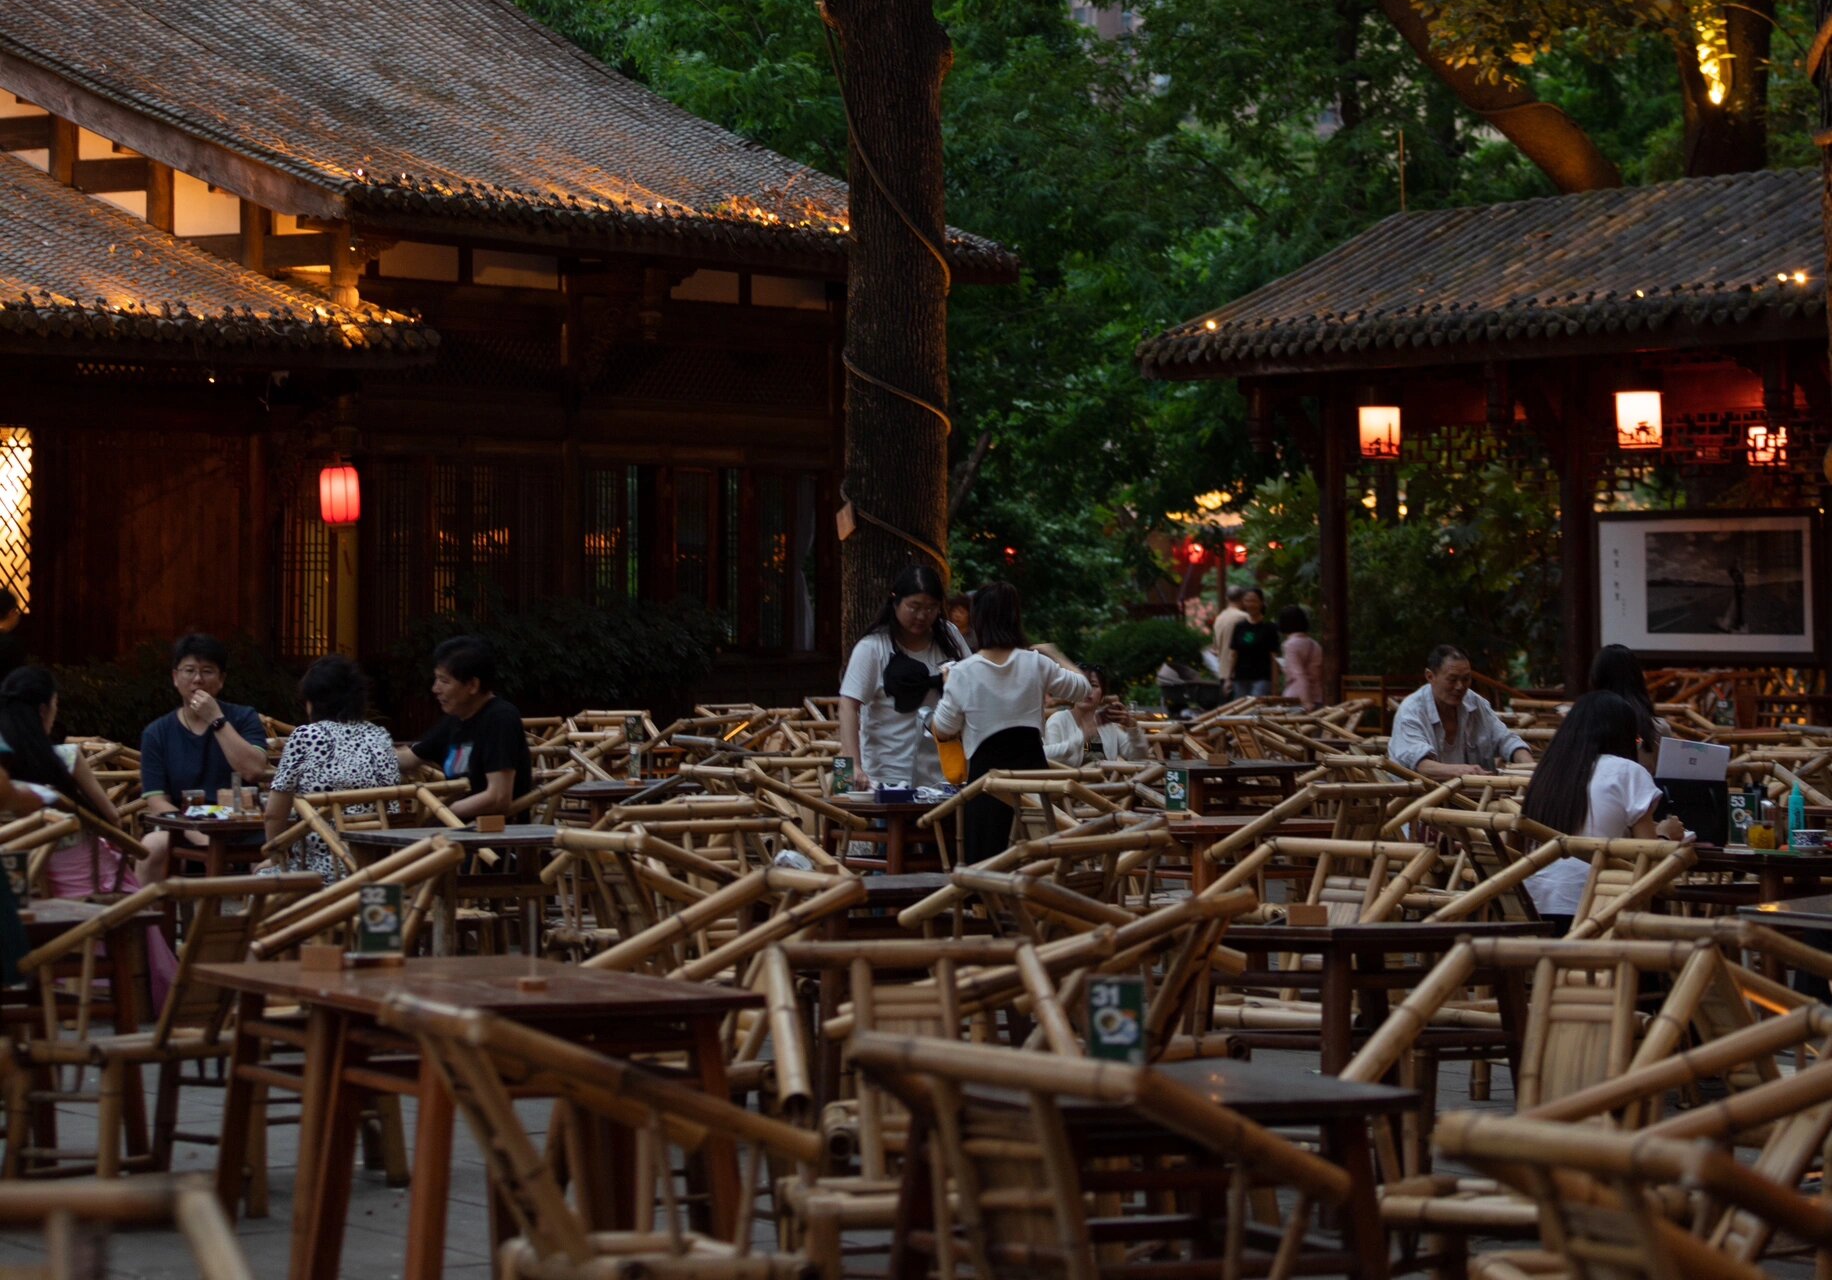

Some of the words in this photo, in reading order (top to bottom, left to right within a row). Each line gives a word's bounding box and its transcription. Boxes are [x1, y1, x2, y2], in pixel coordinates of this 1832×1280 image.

[834, 758, 847, 768] 55
[1167, 771, 1179, 782] 54
[1730, 795, 1745, 808] 53
[361, 886, 387, 904] 32
[1091, 984, 1120, 1007] 31
